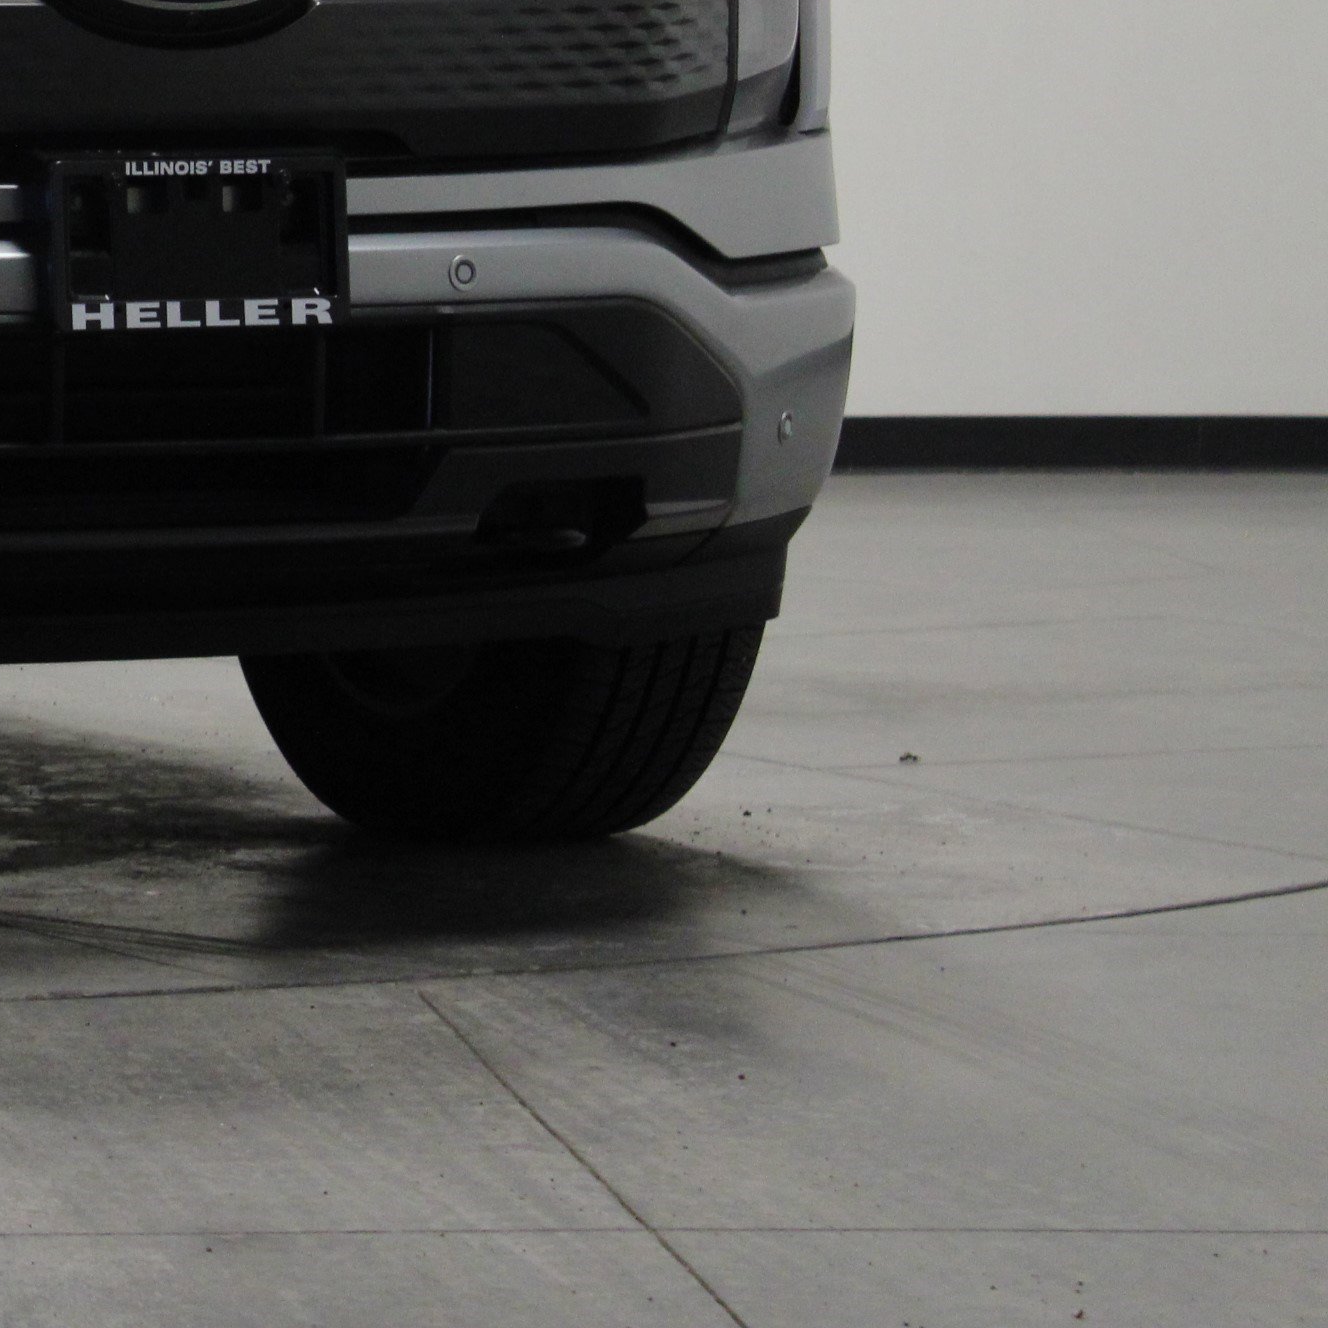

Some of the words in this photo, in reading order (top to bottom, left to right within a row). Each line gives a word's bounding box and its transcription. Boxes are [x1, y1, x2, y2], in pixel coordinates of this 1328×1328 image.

[125, 160, 213, 176] ILLINOIS'
[219, 159, 271, 175] BEST
[71, 297, 333, 330] HELLER
